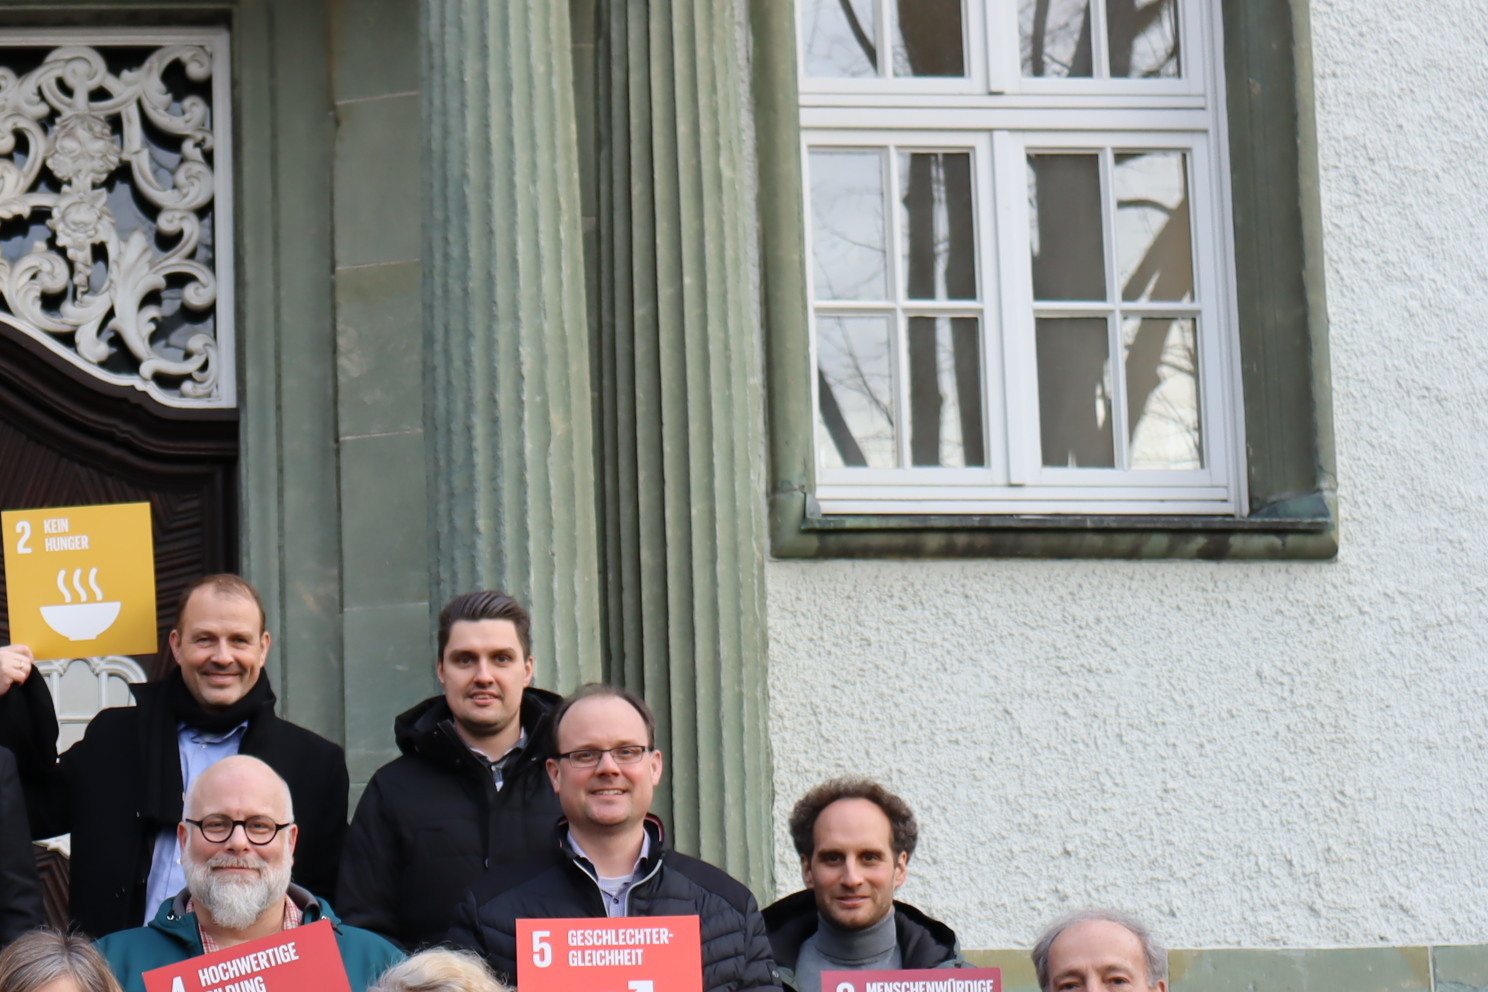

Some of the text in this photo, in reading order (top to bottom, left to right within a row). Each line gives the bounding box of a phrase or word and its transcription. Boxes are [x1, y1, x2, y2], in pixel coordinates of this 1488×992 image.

[43, 518, 69, 534] KEIN
[15, 520, 33, 554] 2
[45, 535, 89, 552] HUNGER
[567, 927, 674, 946] GESCHLECHTER-
[532, 930, 553, 968] 5
[568, 949, 644, 967] GLEICHHEIT
[197, 942, 300, 987] HOCHWERTIGE
